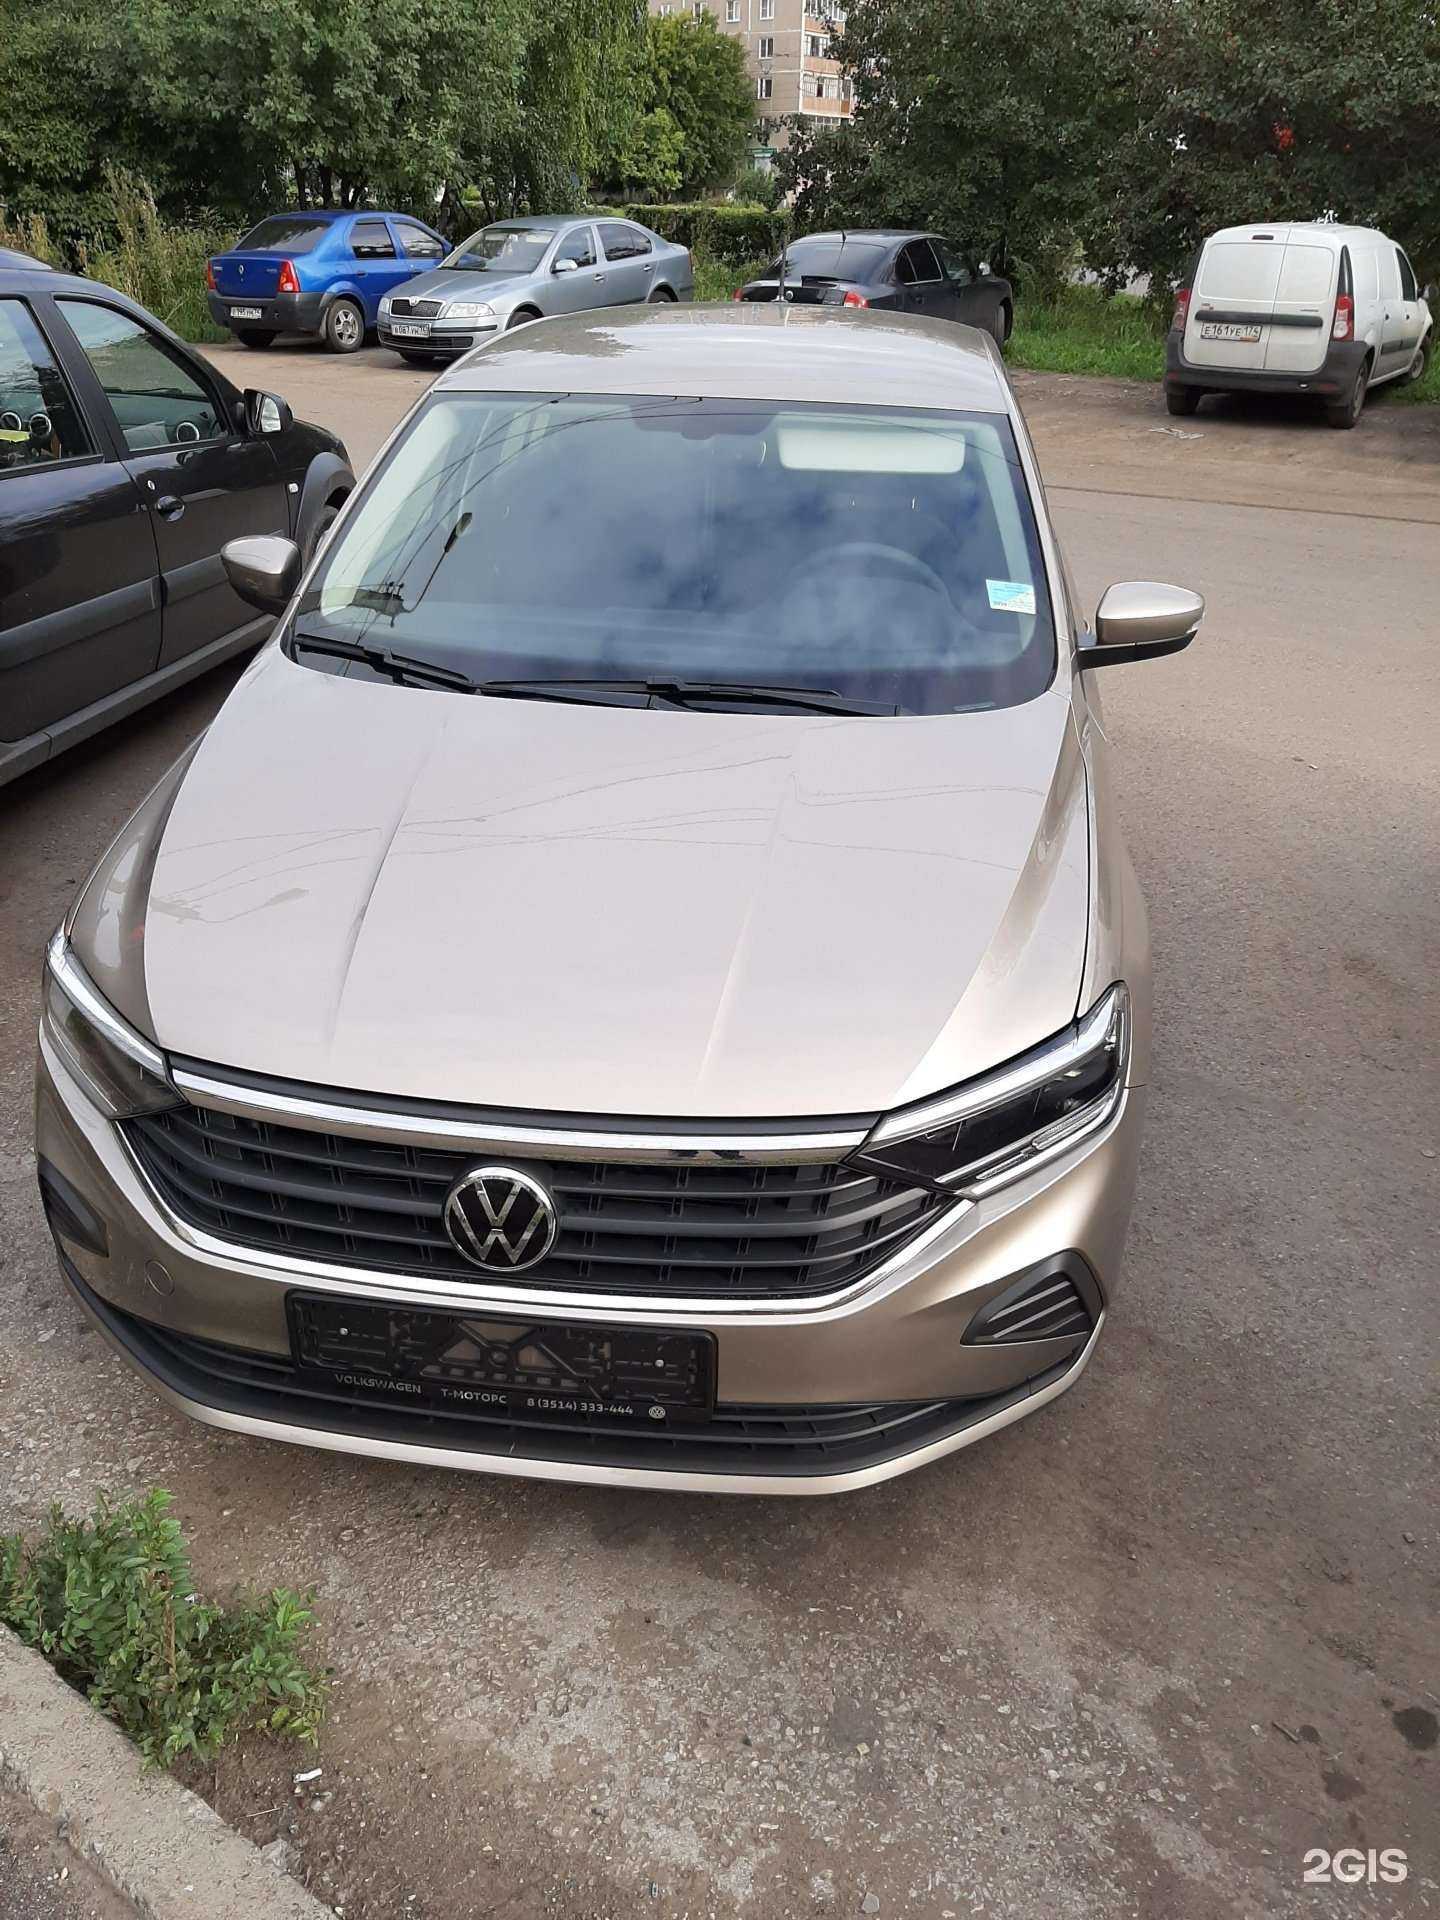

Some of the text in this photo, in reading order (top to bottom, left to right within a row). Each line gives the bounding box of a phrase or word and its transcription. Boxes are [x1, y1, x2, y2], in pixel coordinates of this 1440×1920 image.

[334, 1374, 422, 1394] VOLKSWAGEN
[441, 1388, 634, 1415] Т-МОТОРС 8 (3514) 333-444
